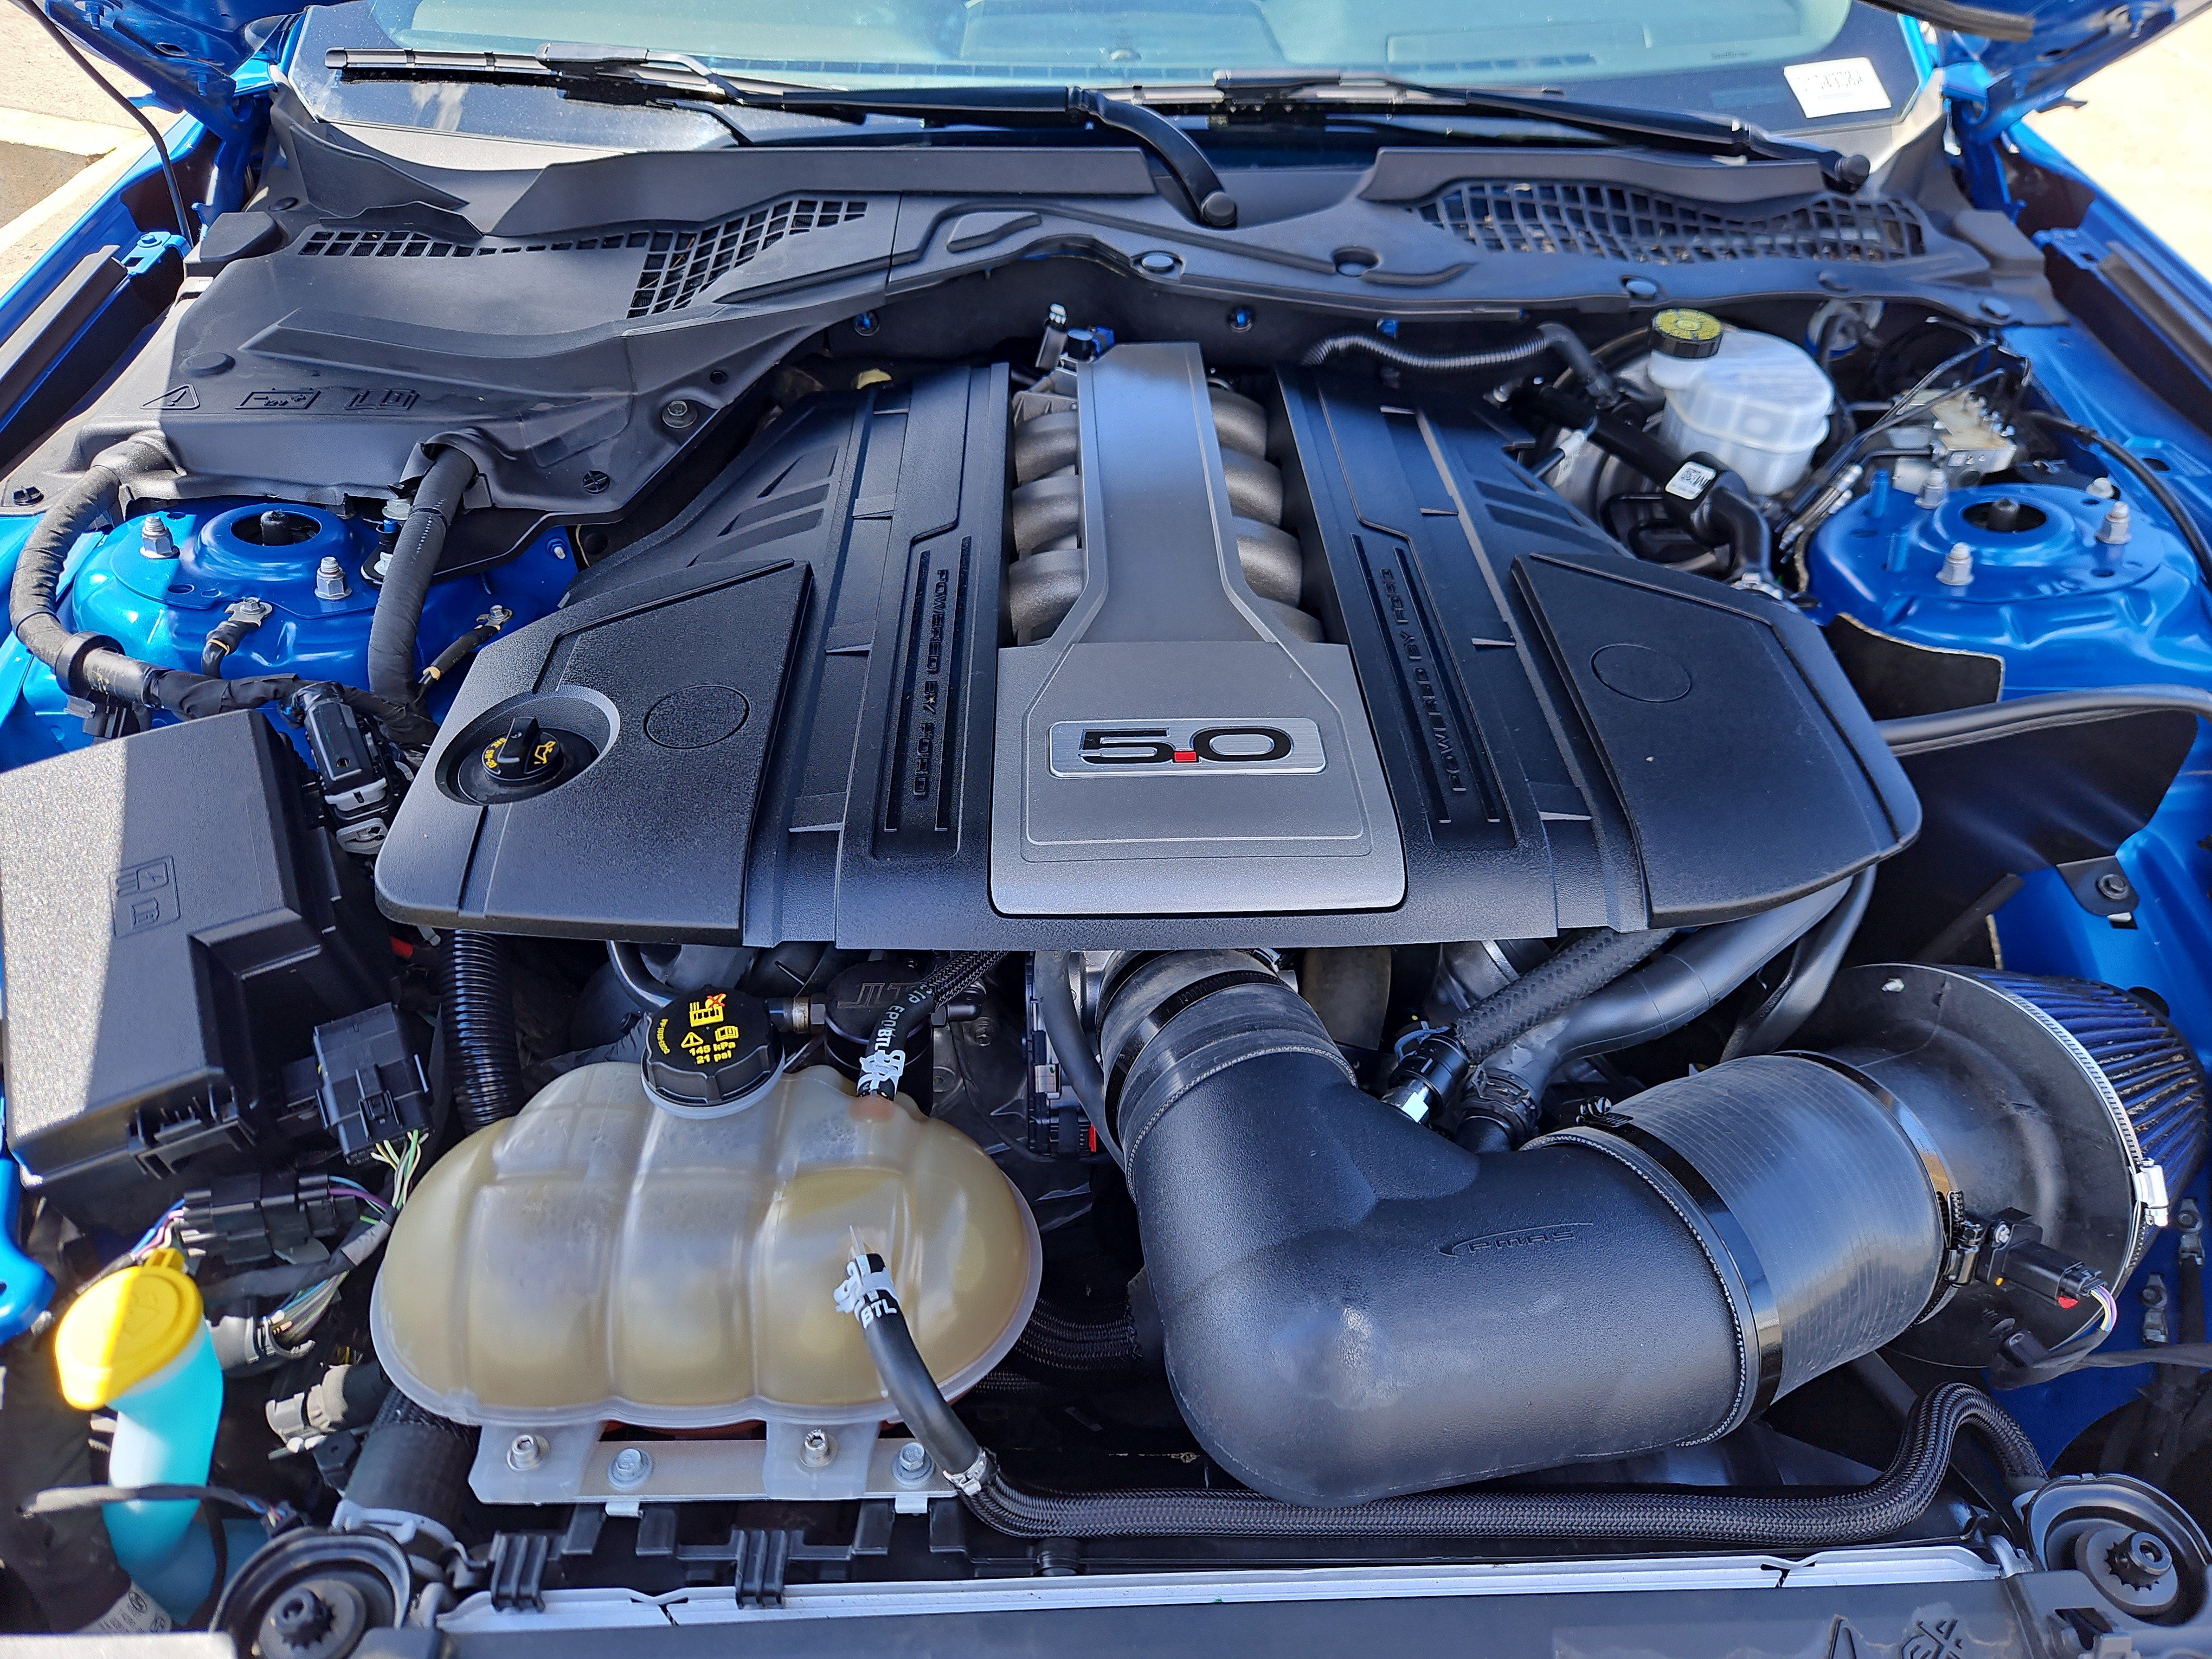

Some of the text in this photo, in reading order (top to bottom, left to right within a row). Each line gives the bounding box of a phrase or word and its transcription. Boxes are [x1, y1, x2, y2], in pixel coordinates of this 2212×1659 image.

[913, 569, 949, 796] POWERED BY FORD
[1380, 568, 1467, 792] POWERED BY FORD
[485, 737, 506, 768] SAE 5W-20
[1079, 726, 1294, 764] 5.0
[689, 1041, 736, 1056] 145 kPa
[696, 1050, 731, 1064] 21 psi
[860, 1298, 897, 1329] BTL
